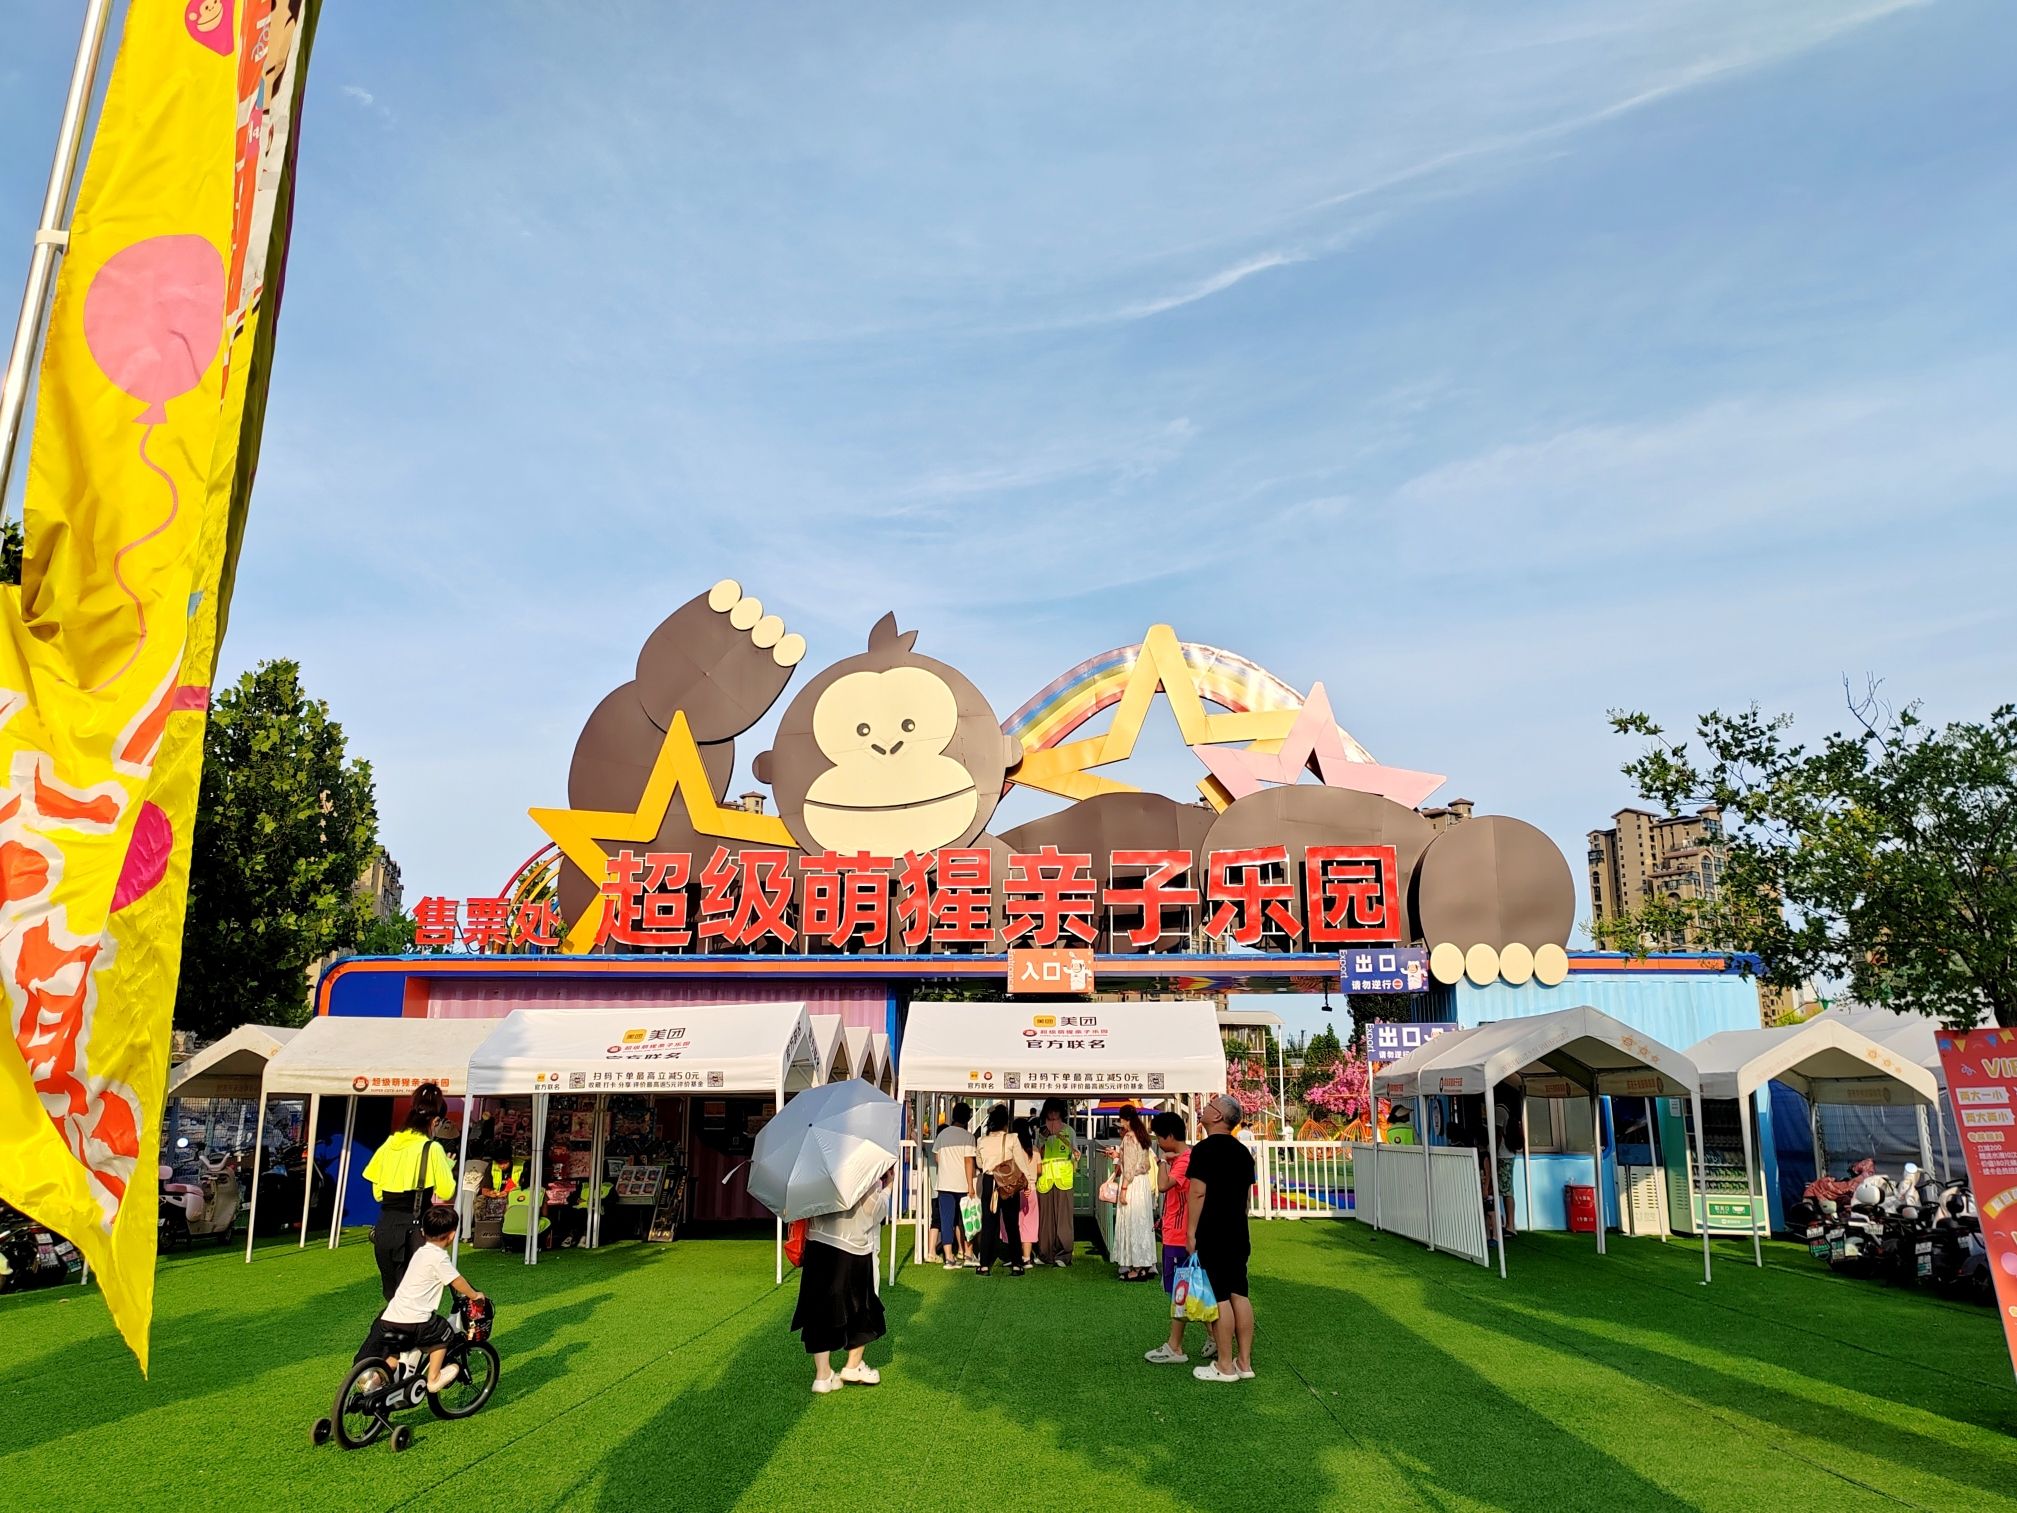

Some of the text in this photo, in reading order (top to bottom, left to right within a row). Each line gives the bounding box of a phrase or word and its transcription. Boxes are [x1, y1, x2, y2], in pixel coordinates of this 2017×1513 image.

[594, 844, 1402, 948] 超级萌猩亲子乐园
[412, 896, 560, 947] 售票处
[1021, 961, 1060, 981] 入口
[1339, 949, 1349, 979] Export
[1355, 954, 1396, 973] 出口
[1351, 980, 1392, 990] 请勿逆行
[1060, 1016, 1097, 1026] 美团
[648, 1028, 686, 1041] 美团
[1378, 1026, 1421, 1047] 出口
[1026, 1039, 1105, 1049] 官方联名
[593, 1071, 700, 1080] 扫码下单最高立减50元
[1028, 1073, 1140, 1081] 扫码下单最高立减50元
